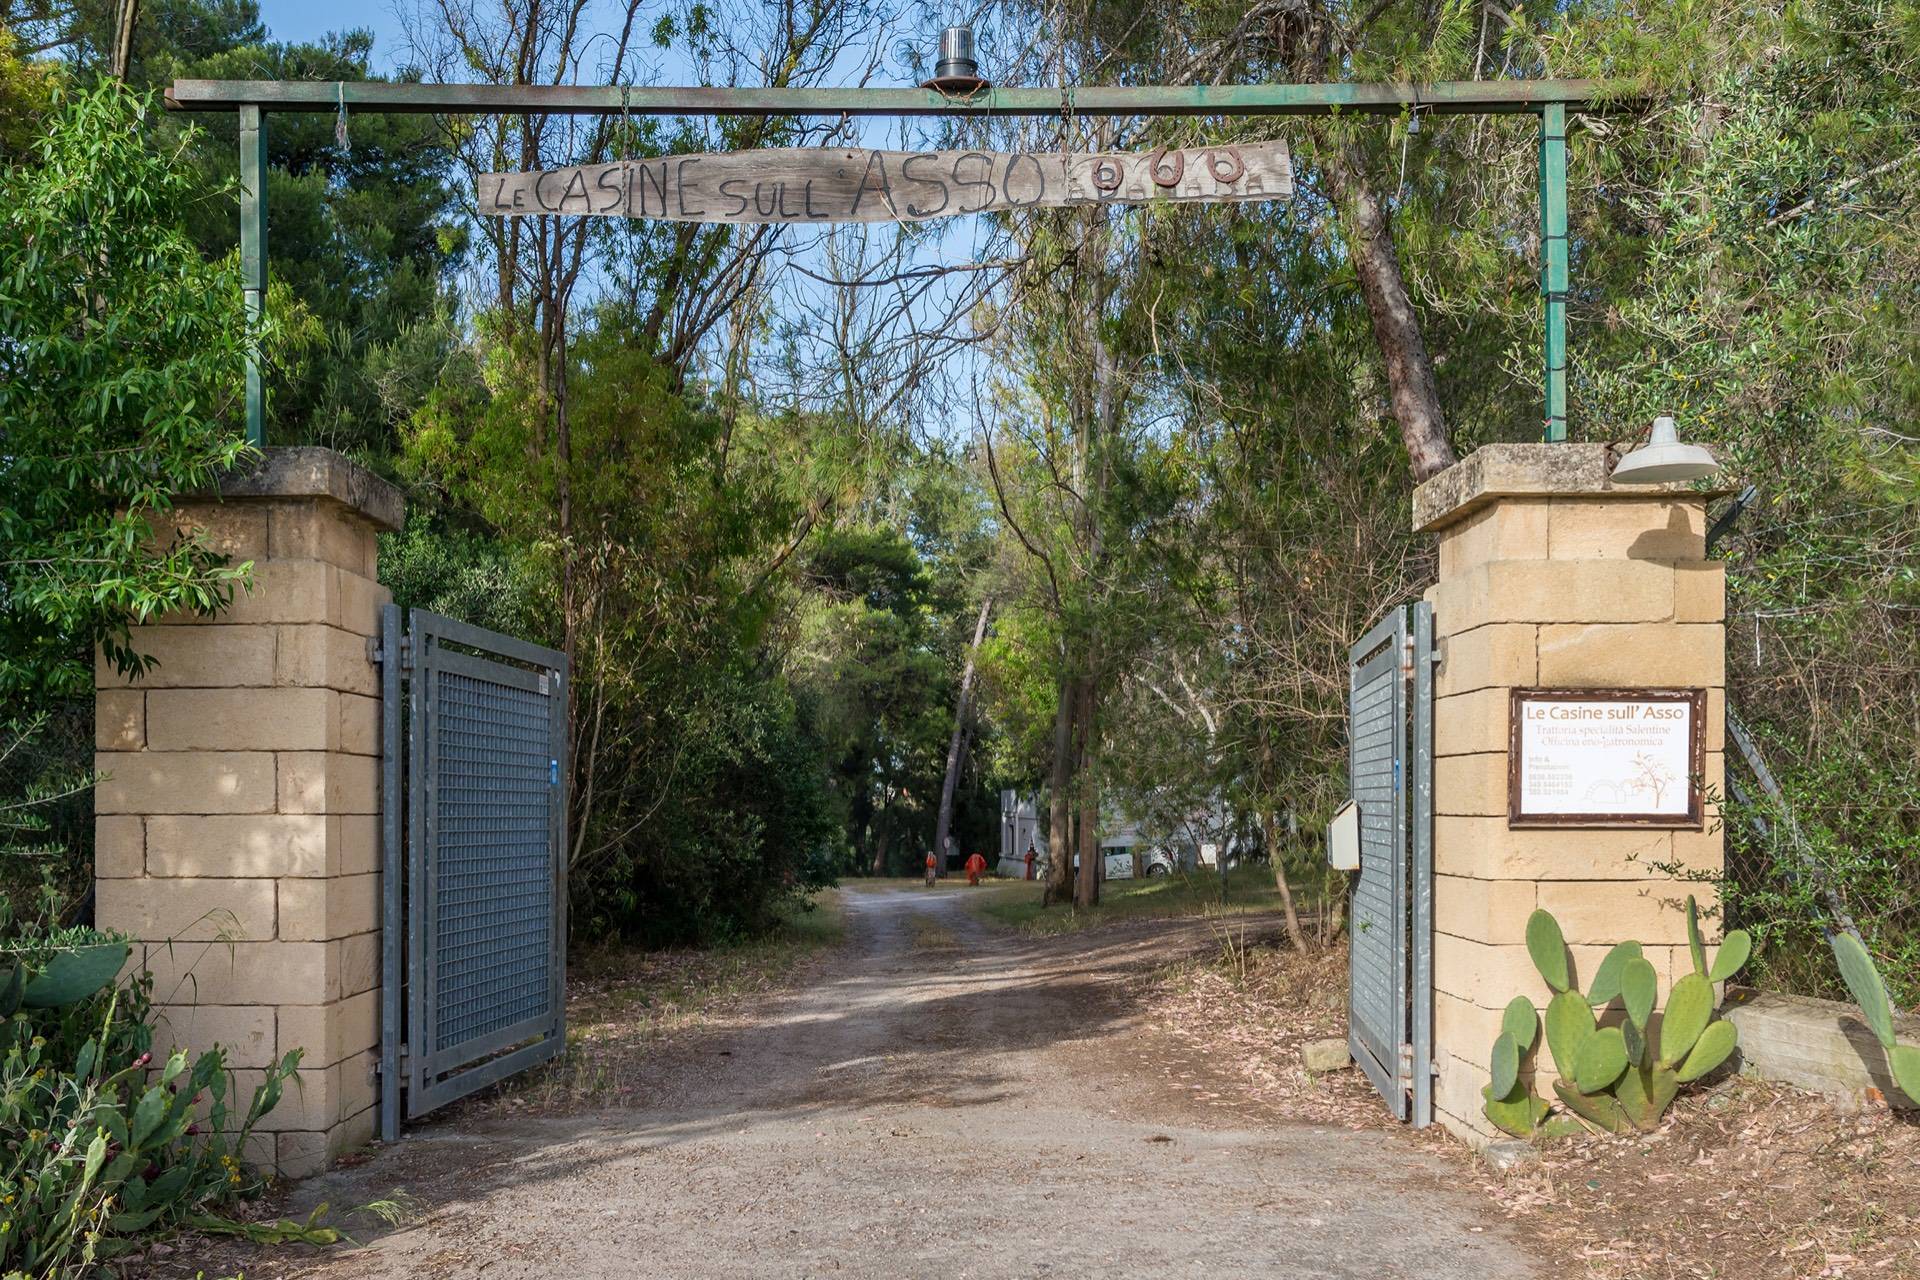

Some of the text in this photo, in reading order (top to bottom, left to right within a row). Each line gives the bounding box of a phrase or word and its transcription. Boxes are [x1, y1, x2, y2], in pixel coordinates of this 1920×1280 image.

[535, 159, 706, 217] CASINE
[851, 150, 1045, 218] ASSO
[1527, 707, 1545, 720] Le
[1550, 706, 1603, 720] Casine
[1643, 706, 1685, 720] Asso
[1536, 725, 1577, 735] Trattoria
[1626, 724, 1671, 735] Salentine
